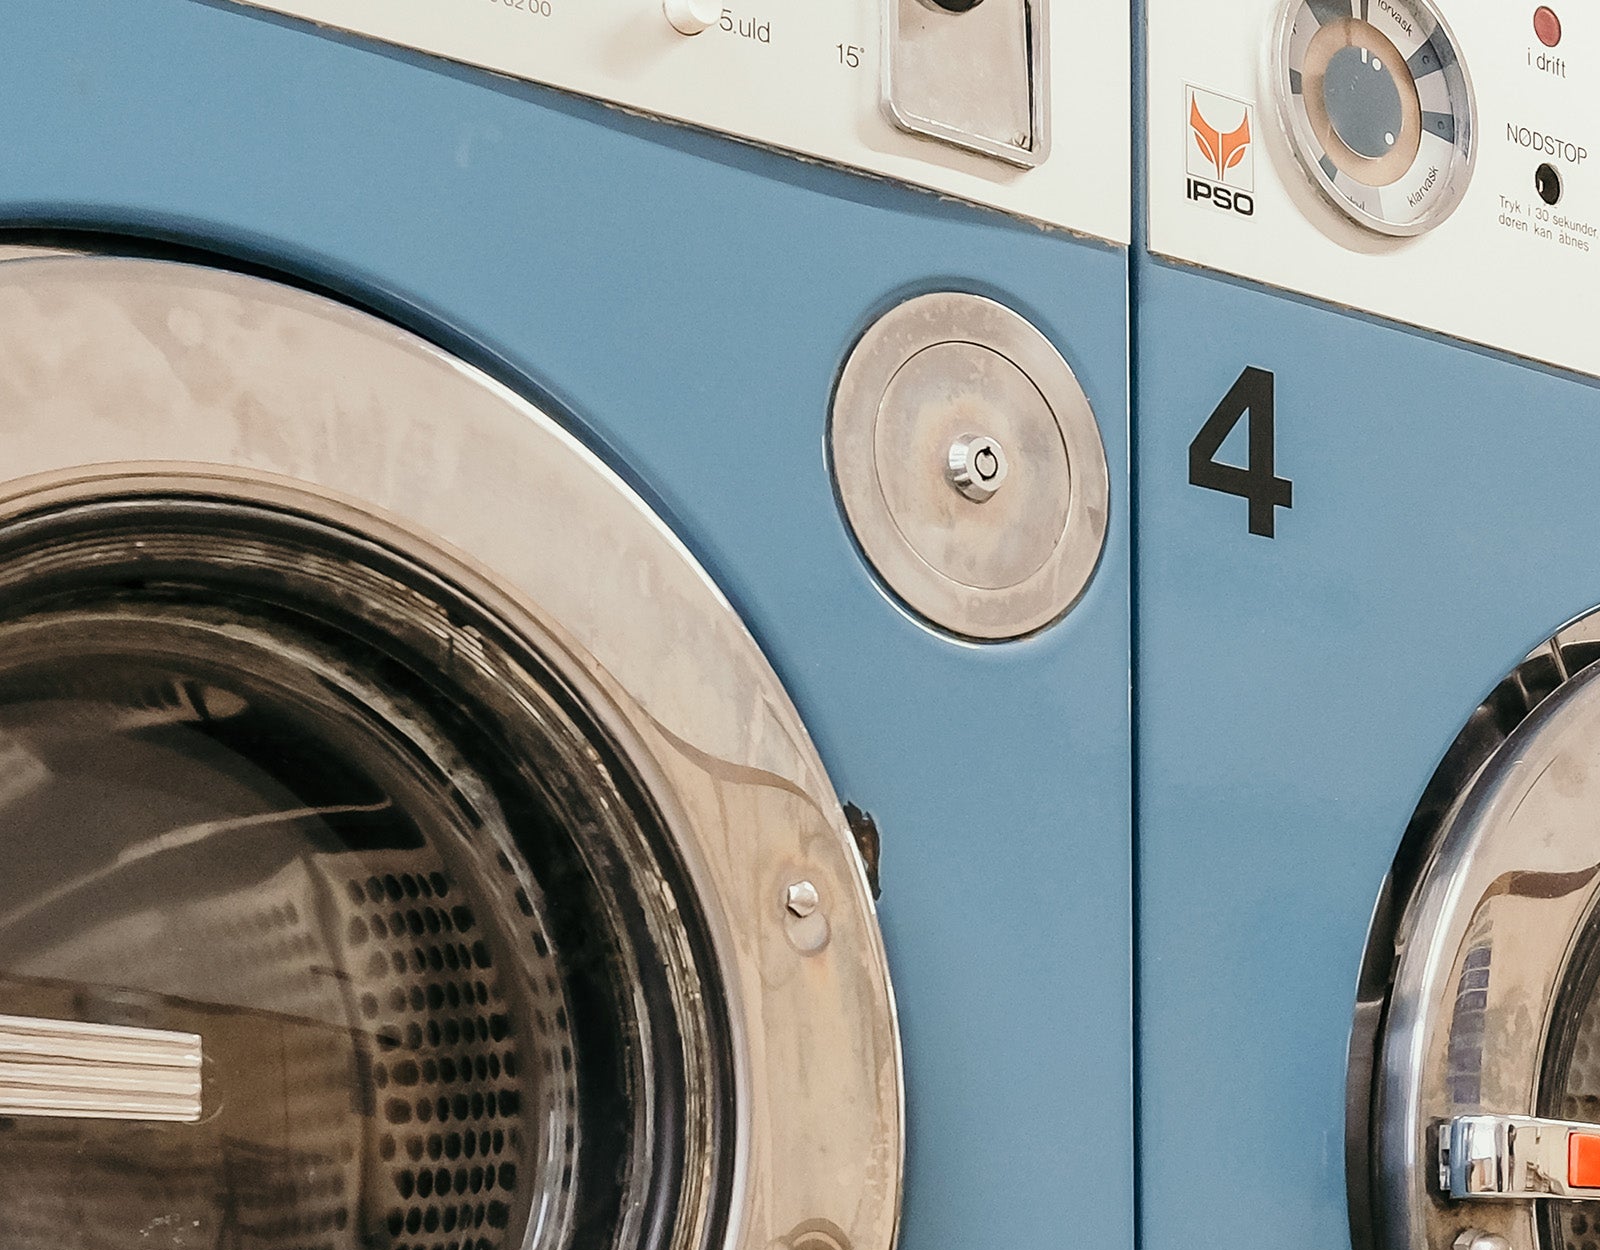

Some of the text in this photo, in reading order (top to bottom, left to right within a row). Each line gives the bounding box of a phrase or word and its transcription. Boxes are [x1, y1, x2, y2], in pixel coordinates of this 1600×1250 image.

[719, 8, 771, 44] 5.uld
[835, 43, 865, 69] 15°
[1526, 47, 1567, 79] i drift
[1506, 122, 1589, 165] NØDSTOP
[1186, 177, 1255, 217] IPSO
[1406, 165, 1440, 208] klarvask
[1499, 194, 1522, 214] Tryk
[1535, 206, 1550, 222] 30
[1533, 222, 1553, 240] kan
[1558, 229, 1591, 252] åbnes
[1188, 364, 1293, 540] 4
